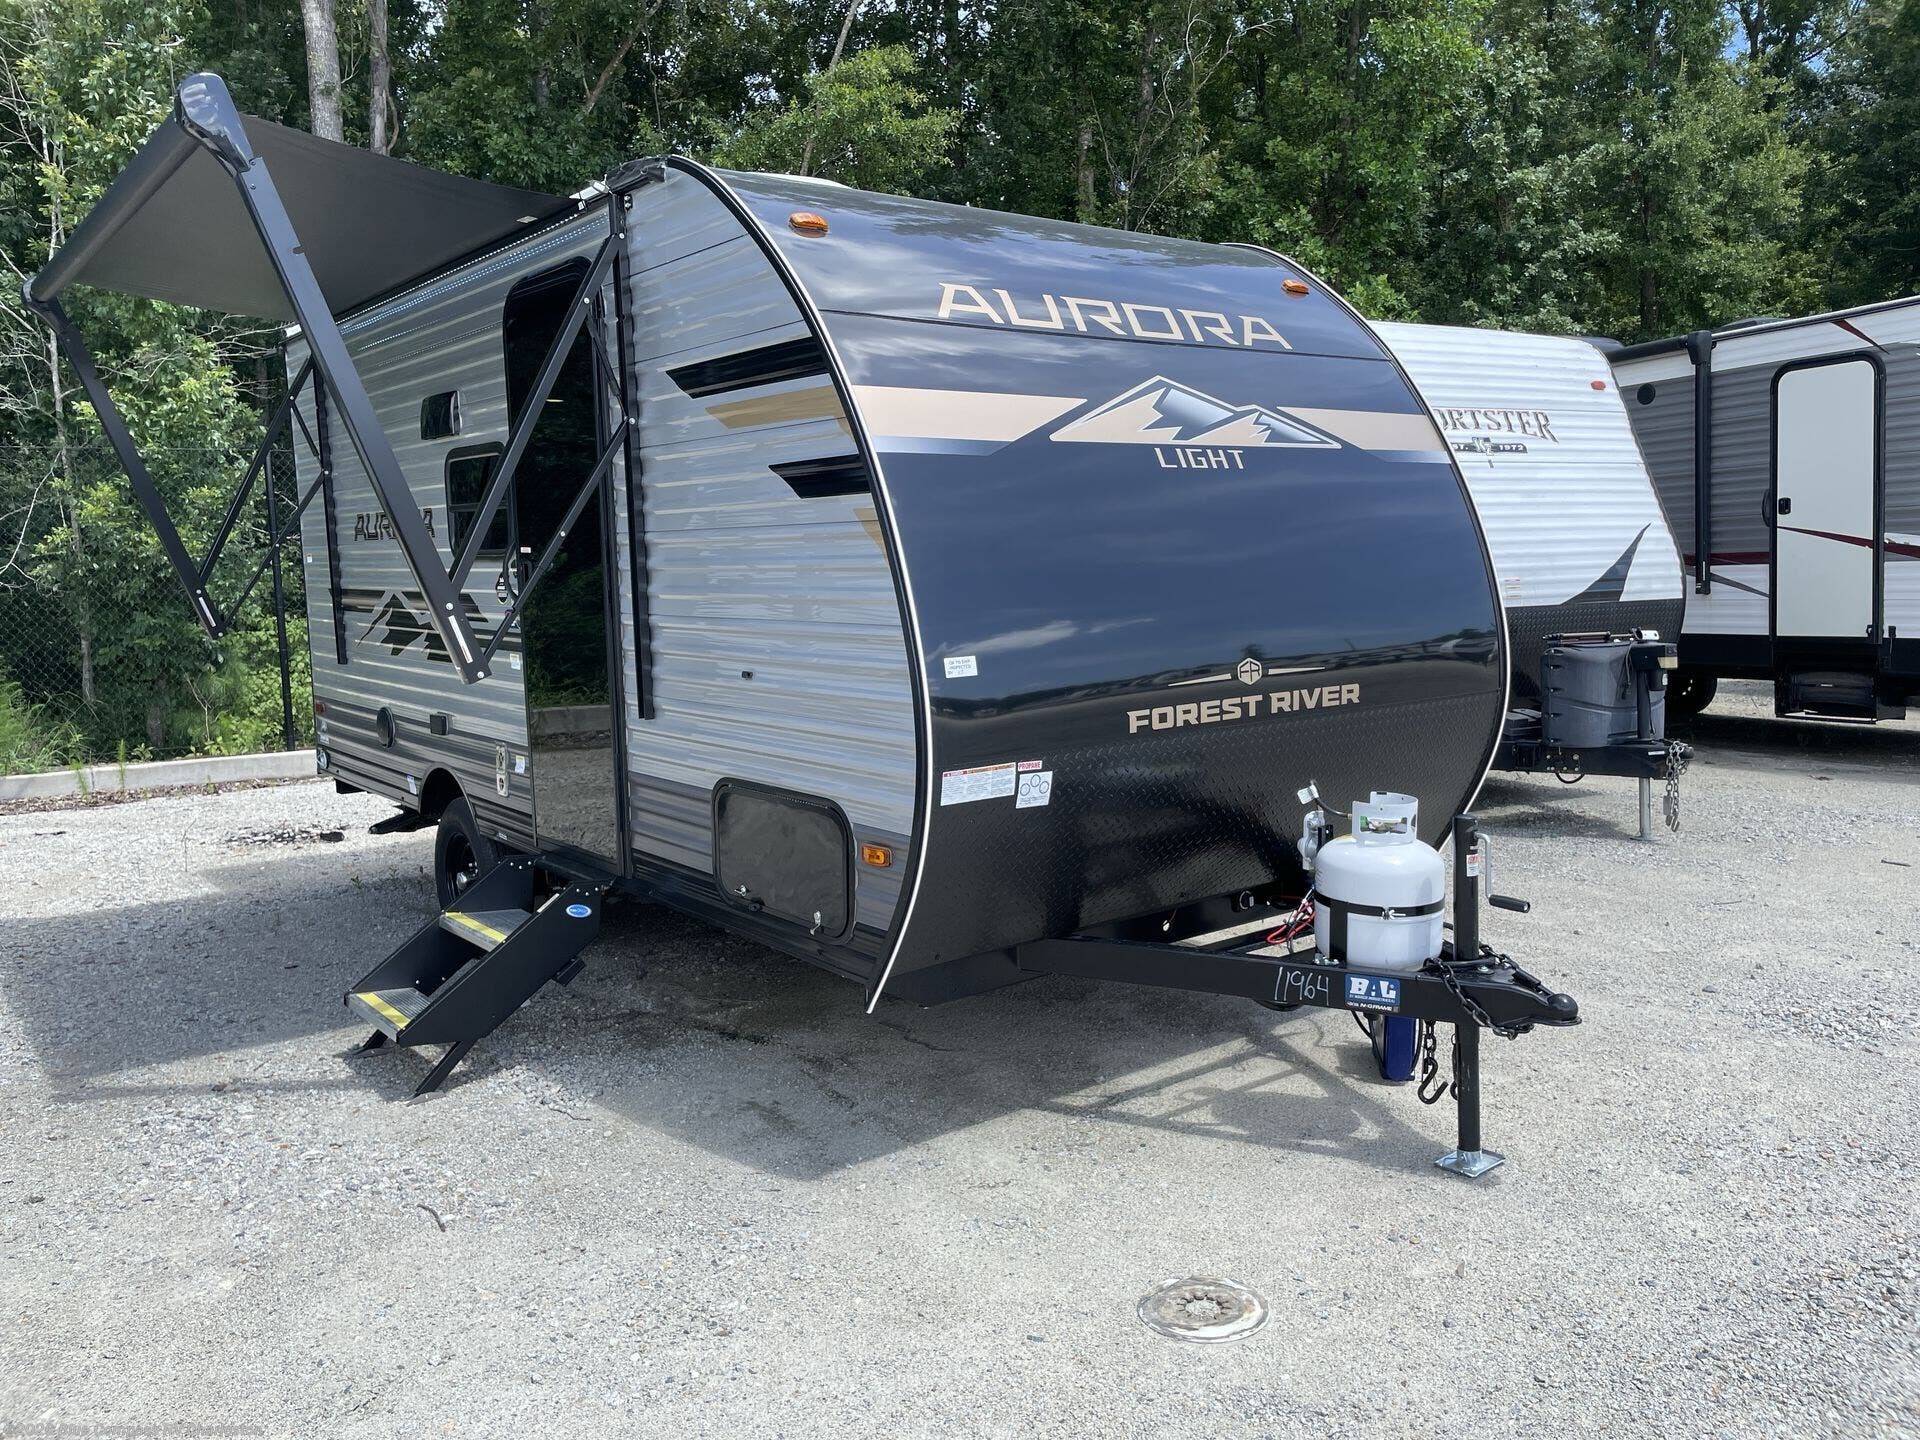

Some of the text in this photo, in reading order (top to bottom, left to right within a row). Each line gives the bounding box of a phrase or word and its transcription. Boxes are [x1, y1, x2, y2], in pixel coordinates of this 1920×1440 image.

[938, 282, 1294, 350] AURORA
[1154, 446, 1245, 470] LIGHT
[354, 508, 435, 541] AURA
[1126, 683, 1360, 734] FOREST RIVER
[1018, 761, 1041, 770] PROPANE
[1274, 966, 1329, 1006] 11964
[1350, 977, 1396, 999] BAL
